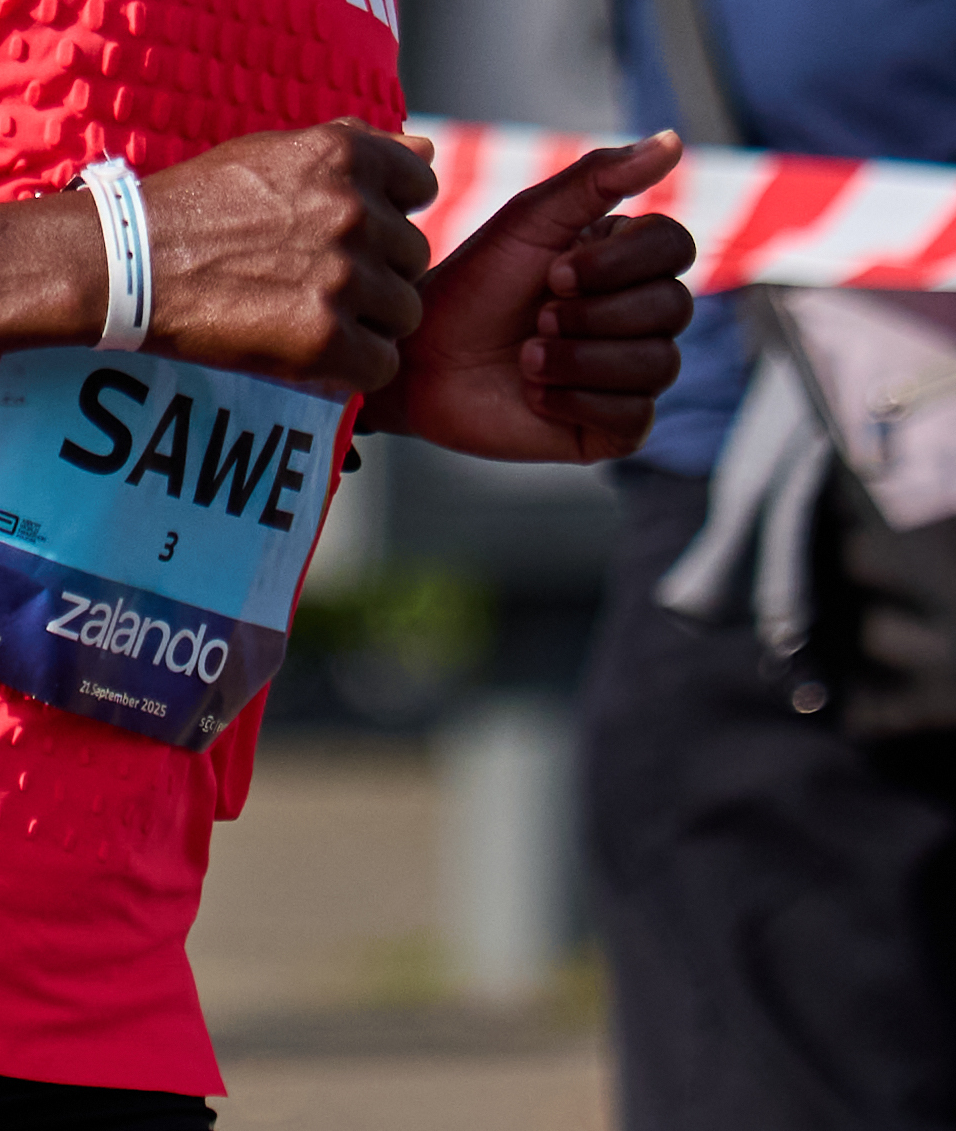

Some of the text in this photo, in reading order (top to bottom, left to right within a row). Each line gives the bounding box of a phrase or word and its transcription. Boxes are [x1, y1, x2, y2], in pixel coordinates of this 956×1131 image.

[58, 368, 314, 533] SAWE
[157, 531, 179, 562] 3
[46, 591, 229, 685] zalando
[90, 683, 140, 709] September
[140, 698, 168, 718] 2025
